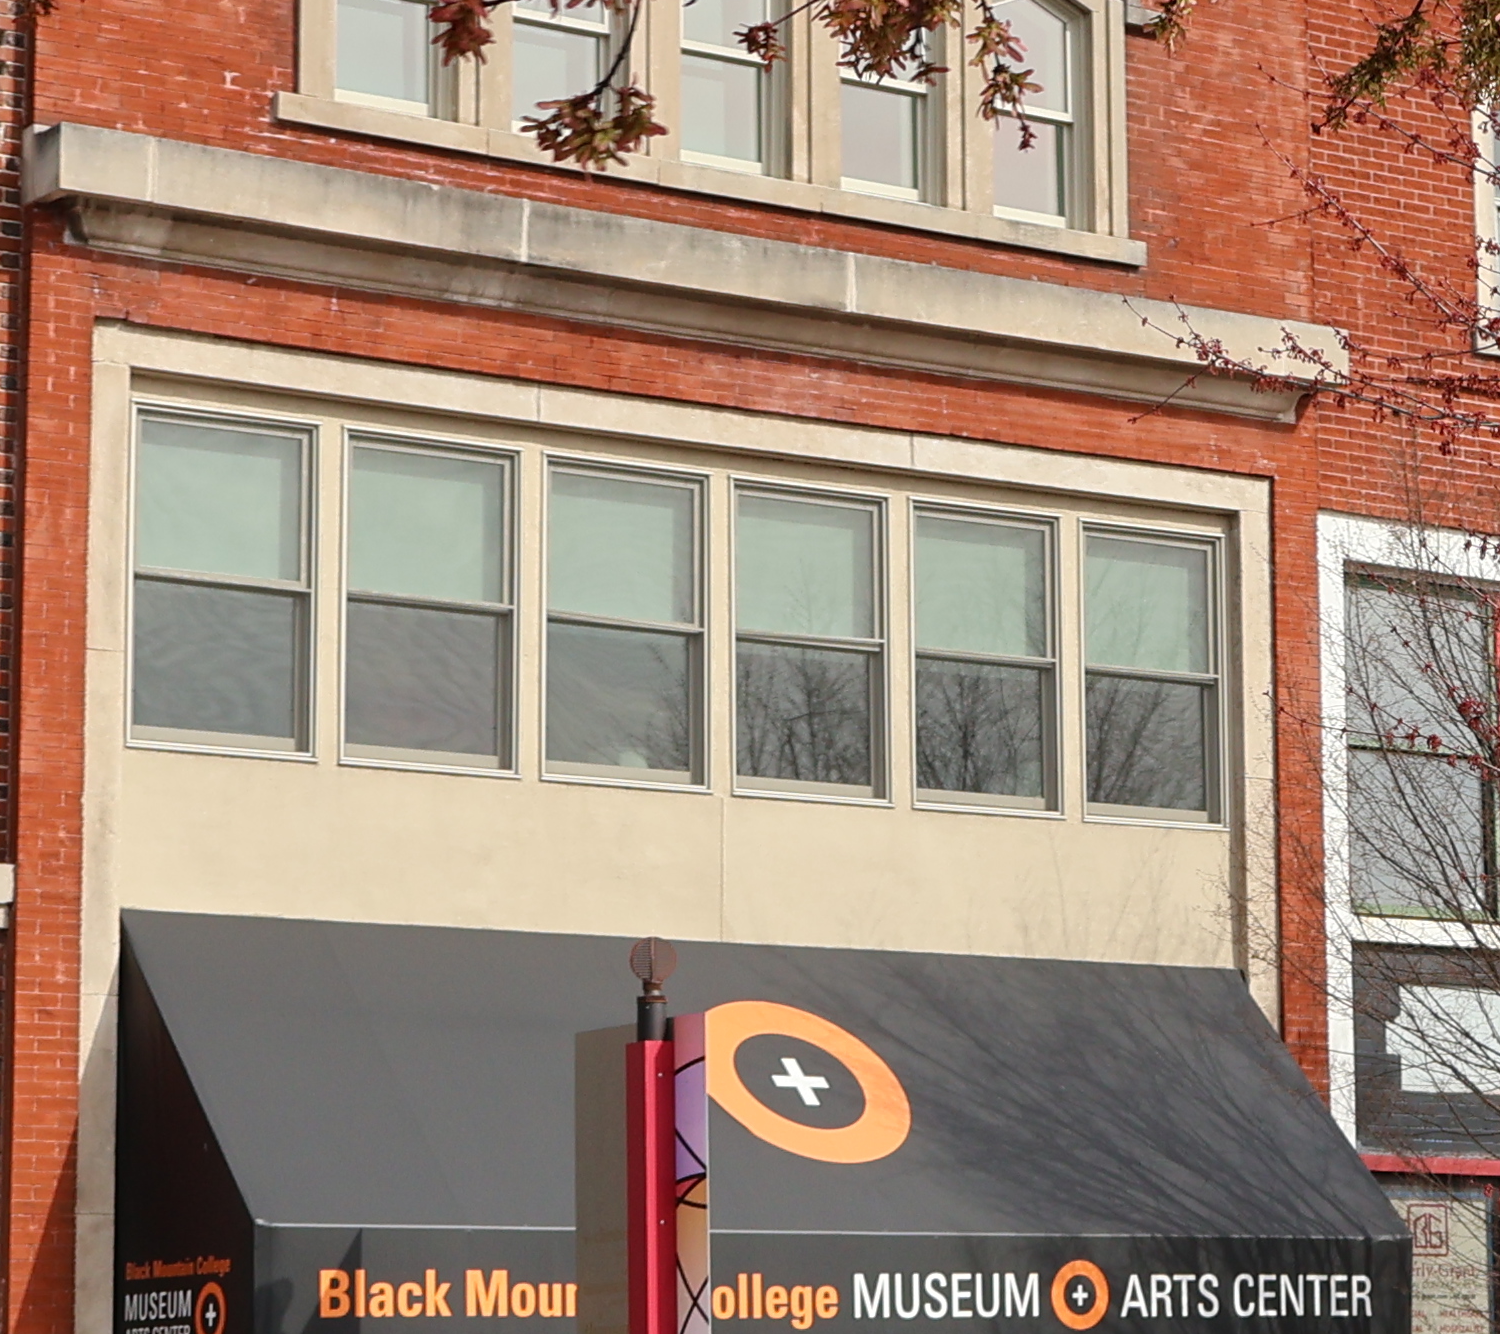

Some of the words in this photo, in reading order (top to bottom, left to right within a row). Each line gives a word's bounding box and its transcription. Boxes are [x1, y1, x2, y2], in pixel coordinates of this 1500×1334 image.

[124, 1289, 192, 1322] MUSEUM
[318, 1269, 451, 1319] Black
[711, 1273, 839, 1330] ollege
[853, 1271, 1041, 1319] MUSEUM
[1120, 1273, 1220, 1319] ARTS
[1233, 1273, 1373, 1318] CENTER
